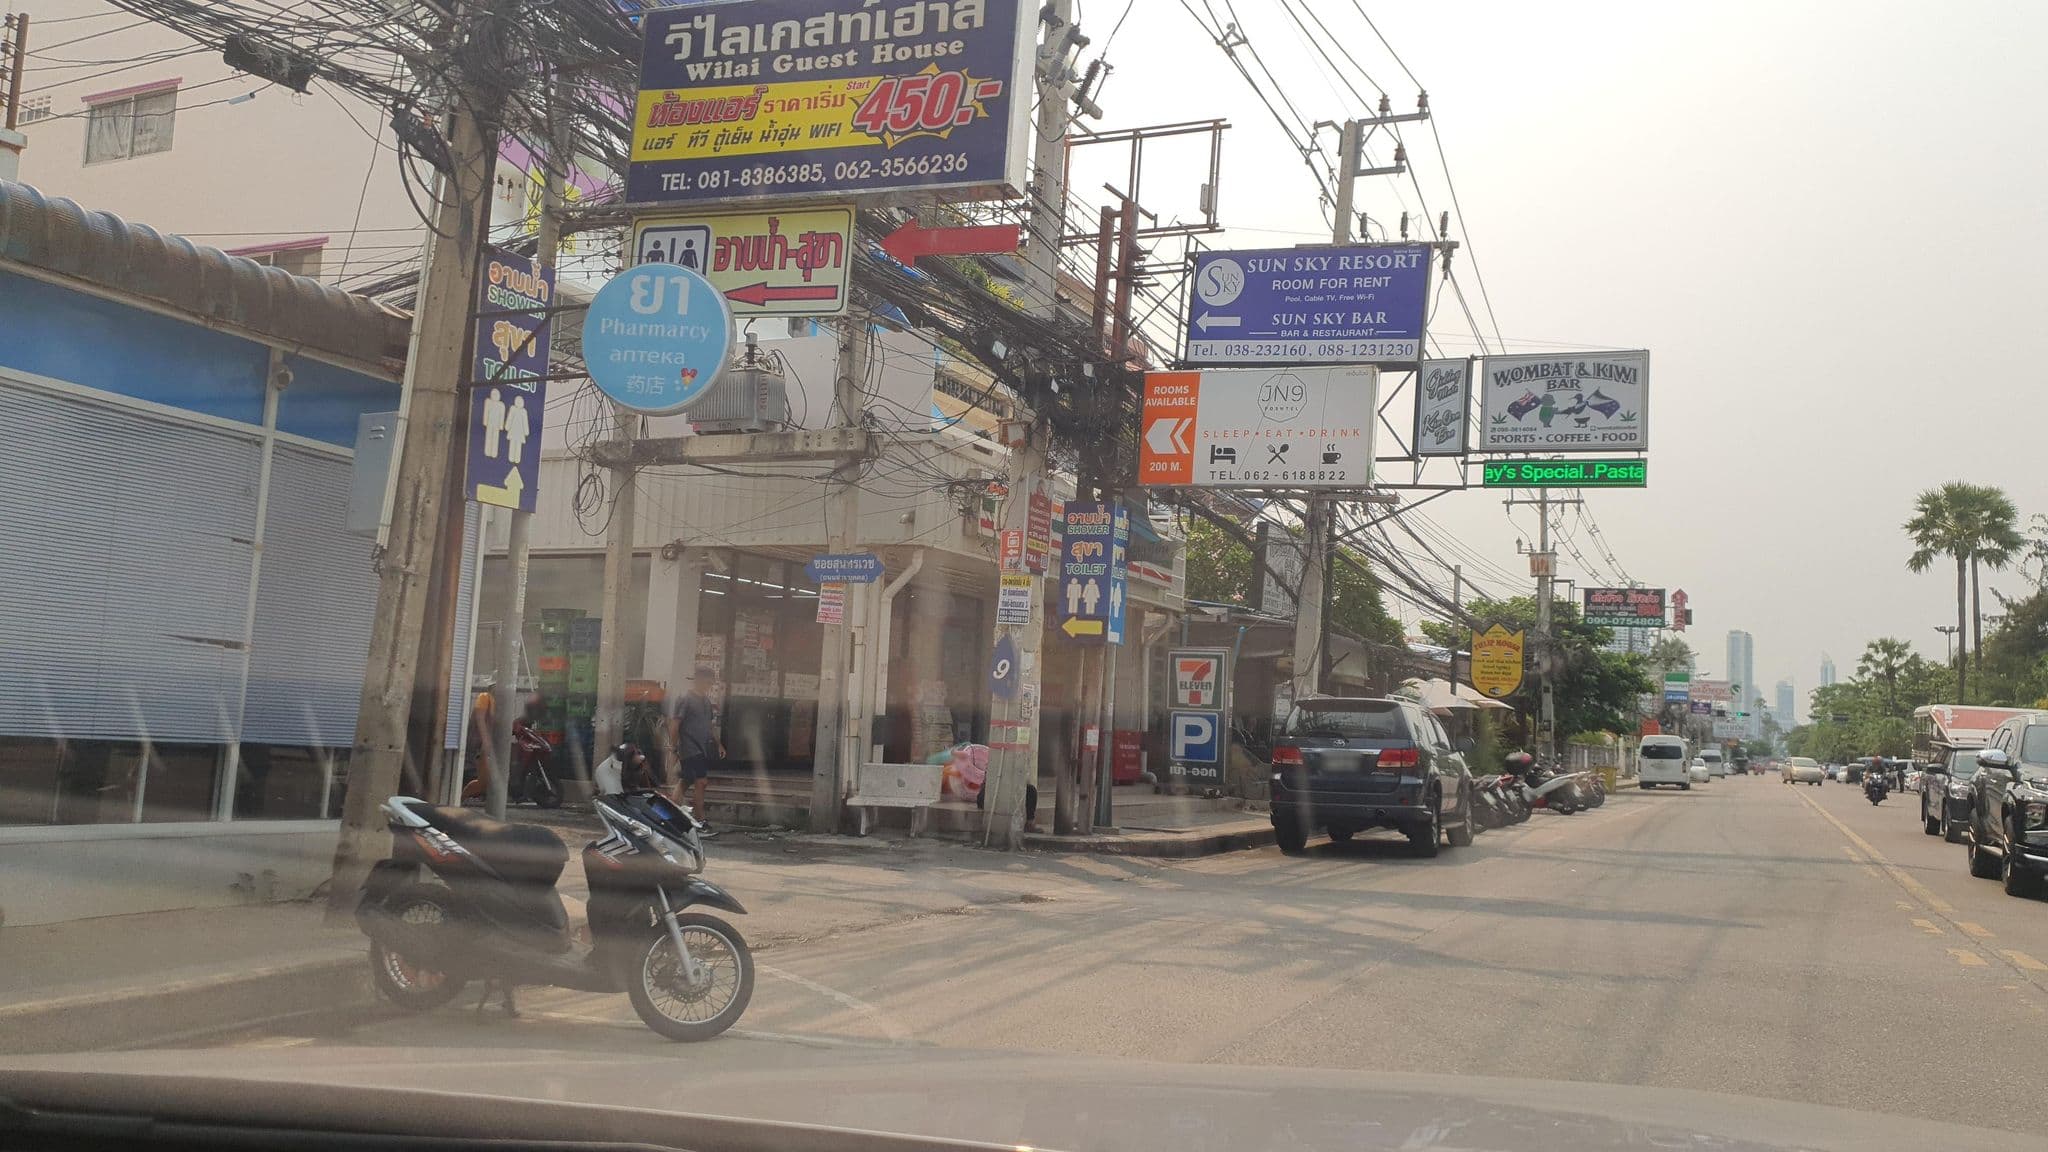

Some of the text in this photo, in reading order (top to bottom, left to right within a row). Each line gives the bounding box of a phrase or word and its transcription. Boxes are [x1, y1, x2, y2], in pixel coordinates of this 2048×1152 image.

[686, 40, 964, 81] Wilai Guest House
[846, 80, 872, 91] Start
[647, 71, 1002, 134] ห้องแอร์ ราคาเริ่ม 450.-
[643, 133, 677, 151] แอร์
[714, 127, 753, 152] ตู้เย็น
[759, 120, 802, 146] น้ำอุ่น
[809, 123, 842, 139] WIFI
[661, 152, 968, 191] TEL: 081-8386385, 062-3566236
[1247, 254, 1422, 273] SUN SKY RESORT
[488, 261, 549, 302] อาบน้ำ
[1272, 276, 1391, 291] ROOM FOR RENT
[488, 285, 546, 320] SHOWER
[630, 275, 690, 315] ยา
[1272, 311, 1388, 326] SUN SKY BAR
[600, 317, 710, 341] Pharmarcy
[1280, 328, 1374, 337] BAR & RESTAURANT
[1192, 344, 1218, 356] Tel.
[1318, 343, 1413, 356] 088-1231230
[483, 358, 540, 393] TOILET
[626, 373, 665, 395] 药店
[1493, 361, 1638, 388] WOMBAT & KIWI
[1153, 385, 1190, 395] ROOMS
[1262, 385, 1304, 402] JN9
[1546, 378, 1582, 392] BAR
[1145, 397, 1197, 407] AVAILABLE
[1203, 428, 1361, 438] SLEEP EAT DRINK
[1490, 432, 1637, 444] SPORTS COFFEE FOOD
[1150, 461, 1183, 472] 200 M.
[1068, 504, 1111, 525] อาบน้ำ
[1067, 525, 1110, 535] SHOWER
[1065, 563, 1107, 575] TOILET
[993, 659, 1011, 679] 9
[1175, 716, 1212, 756] P
